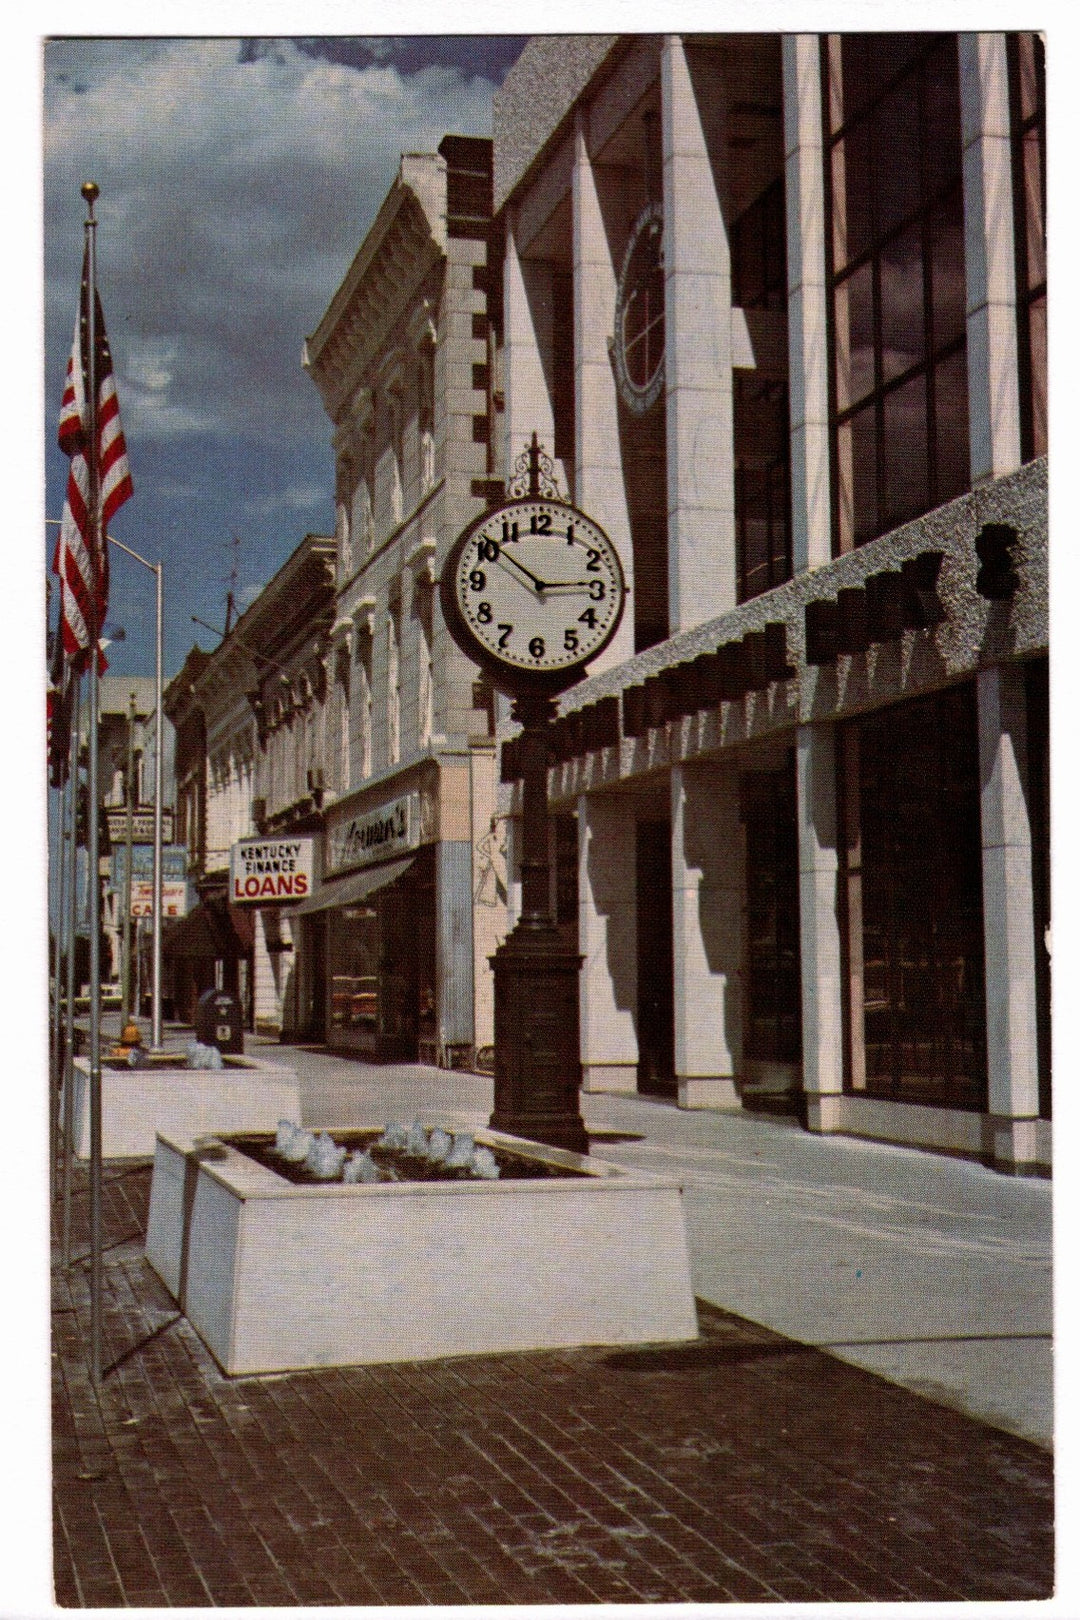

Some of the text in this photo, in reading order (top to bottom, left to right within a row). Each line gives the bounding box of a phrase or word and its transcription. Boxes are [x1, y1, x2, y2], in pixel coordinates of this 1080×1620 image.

[502, 521, 519, 542] 11
[530, 515, 552, 536] 12
[566, 525, 574, 545] 1
[477, 538, 500, 562] 10
[586, 549, 601, 571] 2
[469, 571, 486, 592] 9
[589, 580, 605, 601] 3
[477, 602, 493, 623] 8
[578, 608, 598, 629] 4
[498, 624, 513, 648] 7
[564, 629, 579, 650] 5
[529, 637, 545, 658] 6
[241, 844, 301, 860] KENTUCKY
[246, 859, 296, 874] FINANCE
[234, 873, 308, 897] LOANS
[132, 903, 177, 916] CAE
